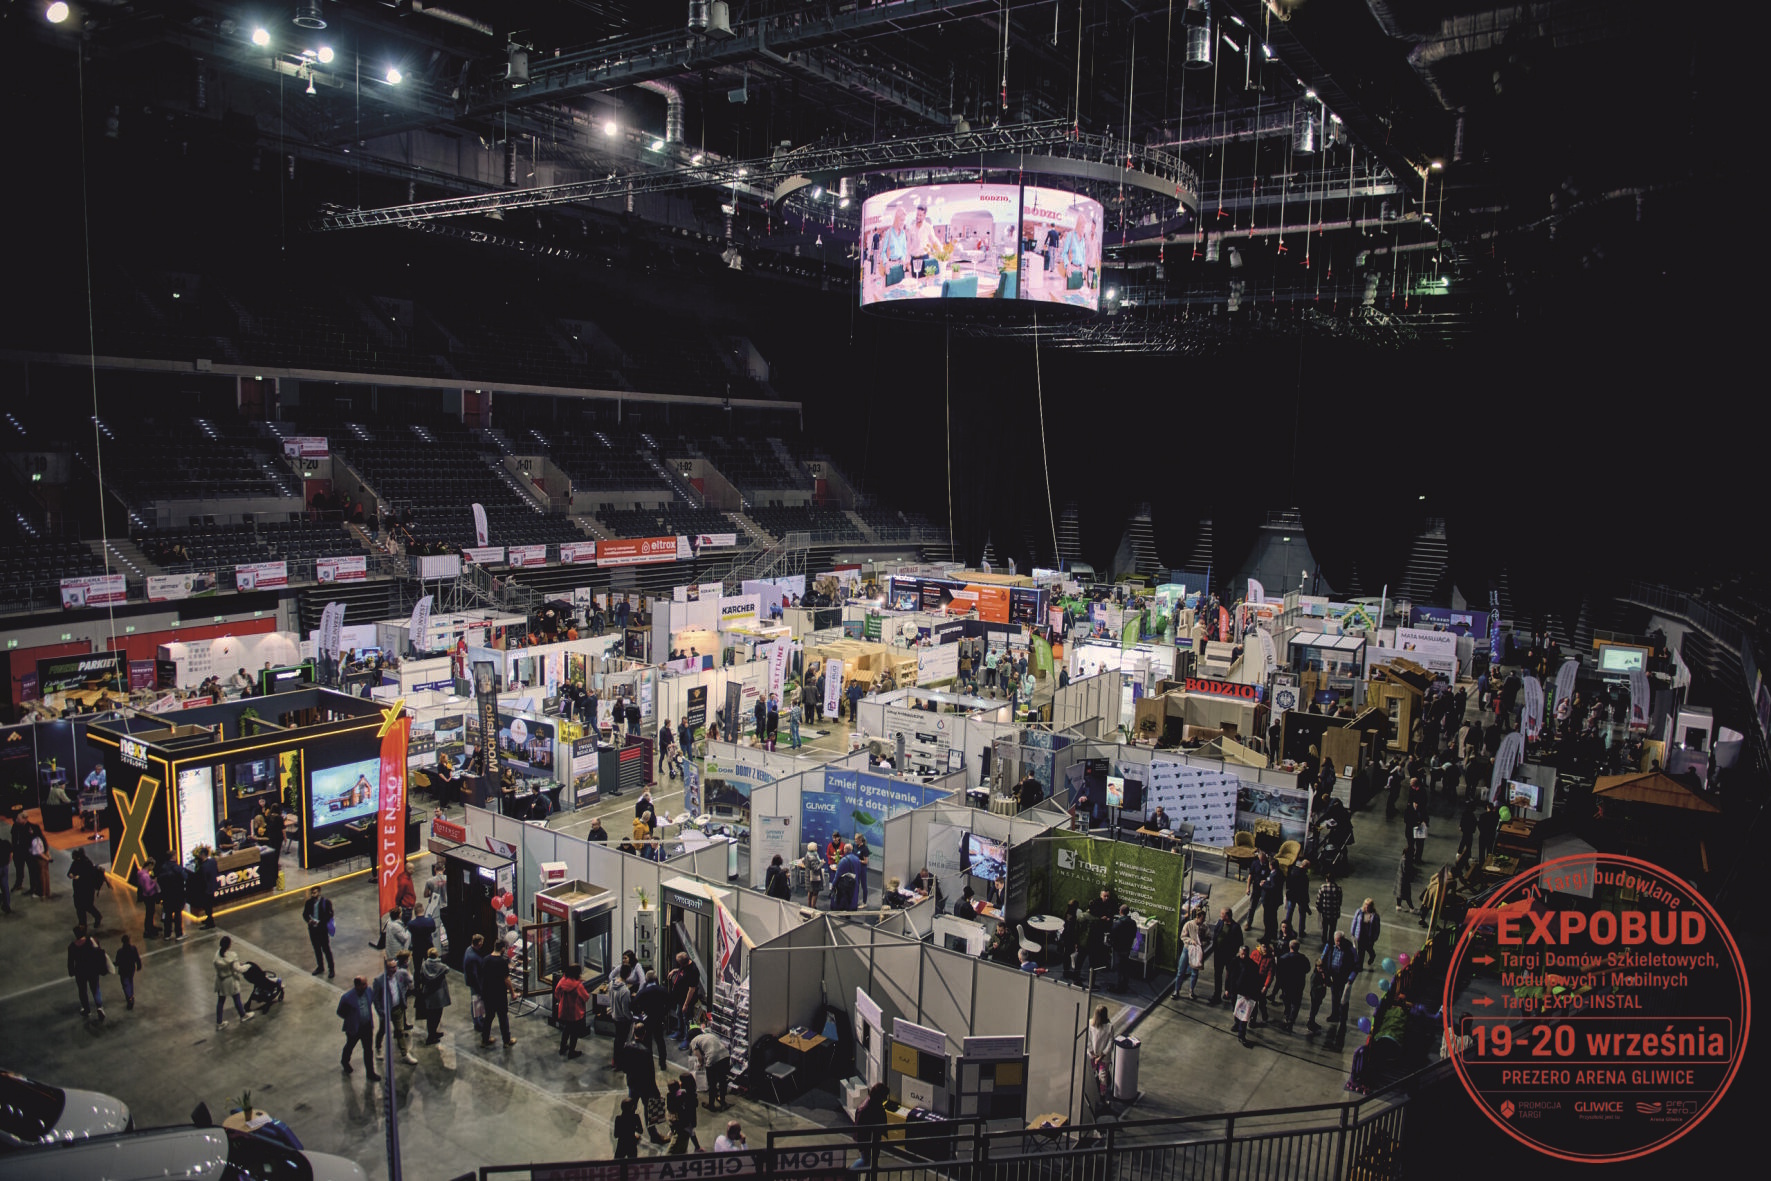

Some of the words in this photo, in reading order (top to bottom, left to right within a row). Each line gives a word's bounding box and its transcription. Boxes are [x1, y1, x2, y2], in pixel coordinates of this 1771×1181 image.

[1185, 677, 1254, 699] BODZIO
[828, 776, 857, 790] Zmień
[860, 784, 919, 806] ogrzewanie,
[806, 802, 836, 812] GLIWICE
[383, 776, 400, 888] ROTENSO
[216, 865, 260, 887] nexx
[214, 880, 261, 897] DEVELOPER
[910, 1092, 924, 1102] GAZ
